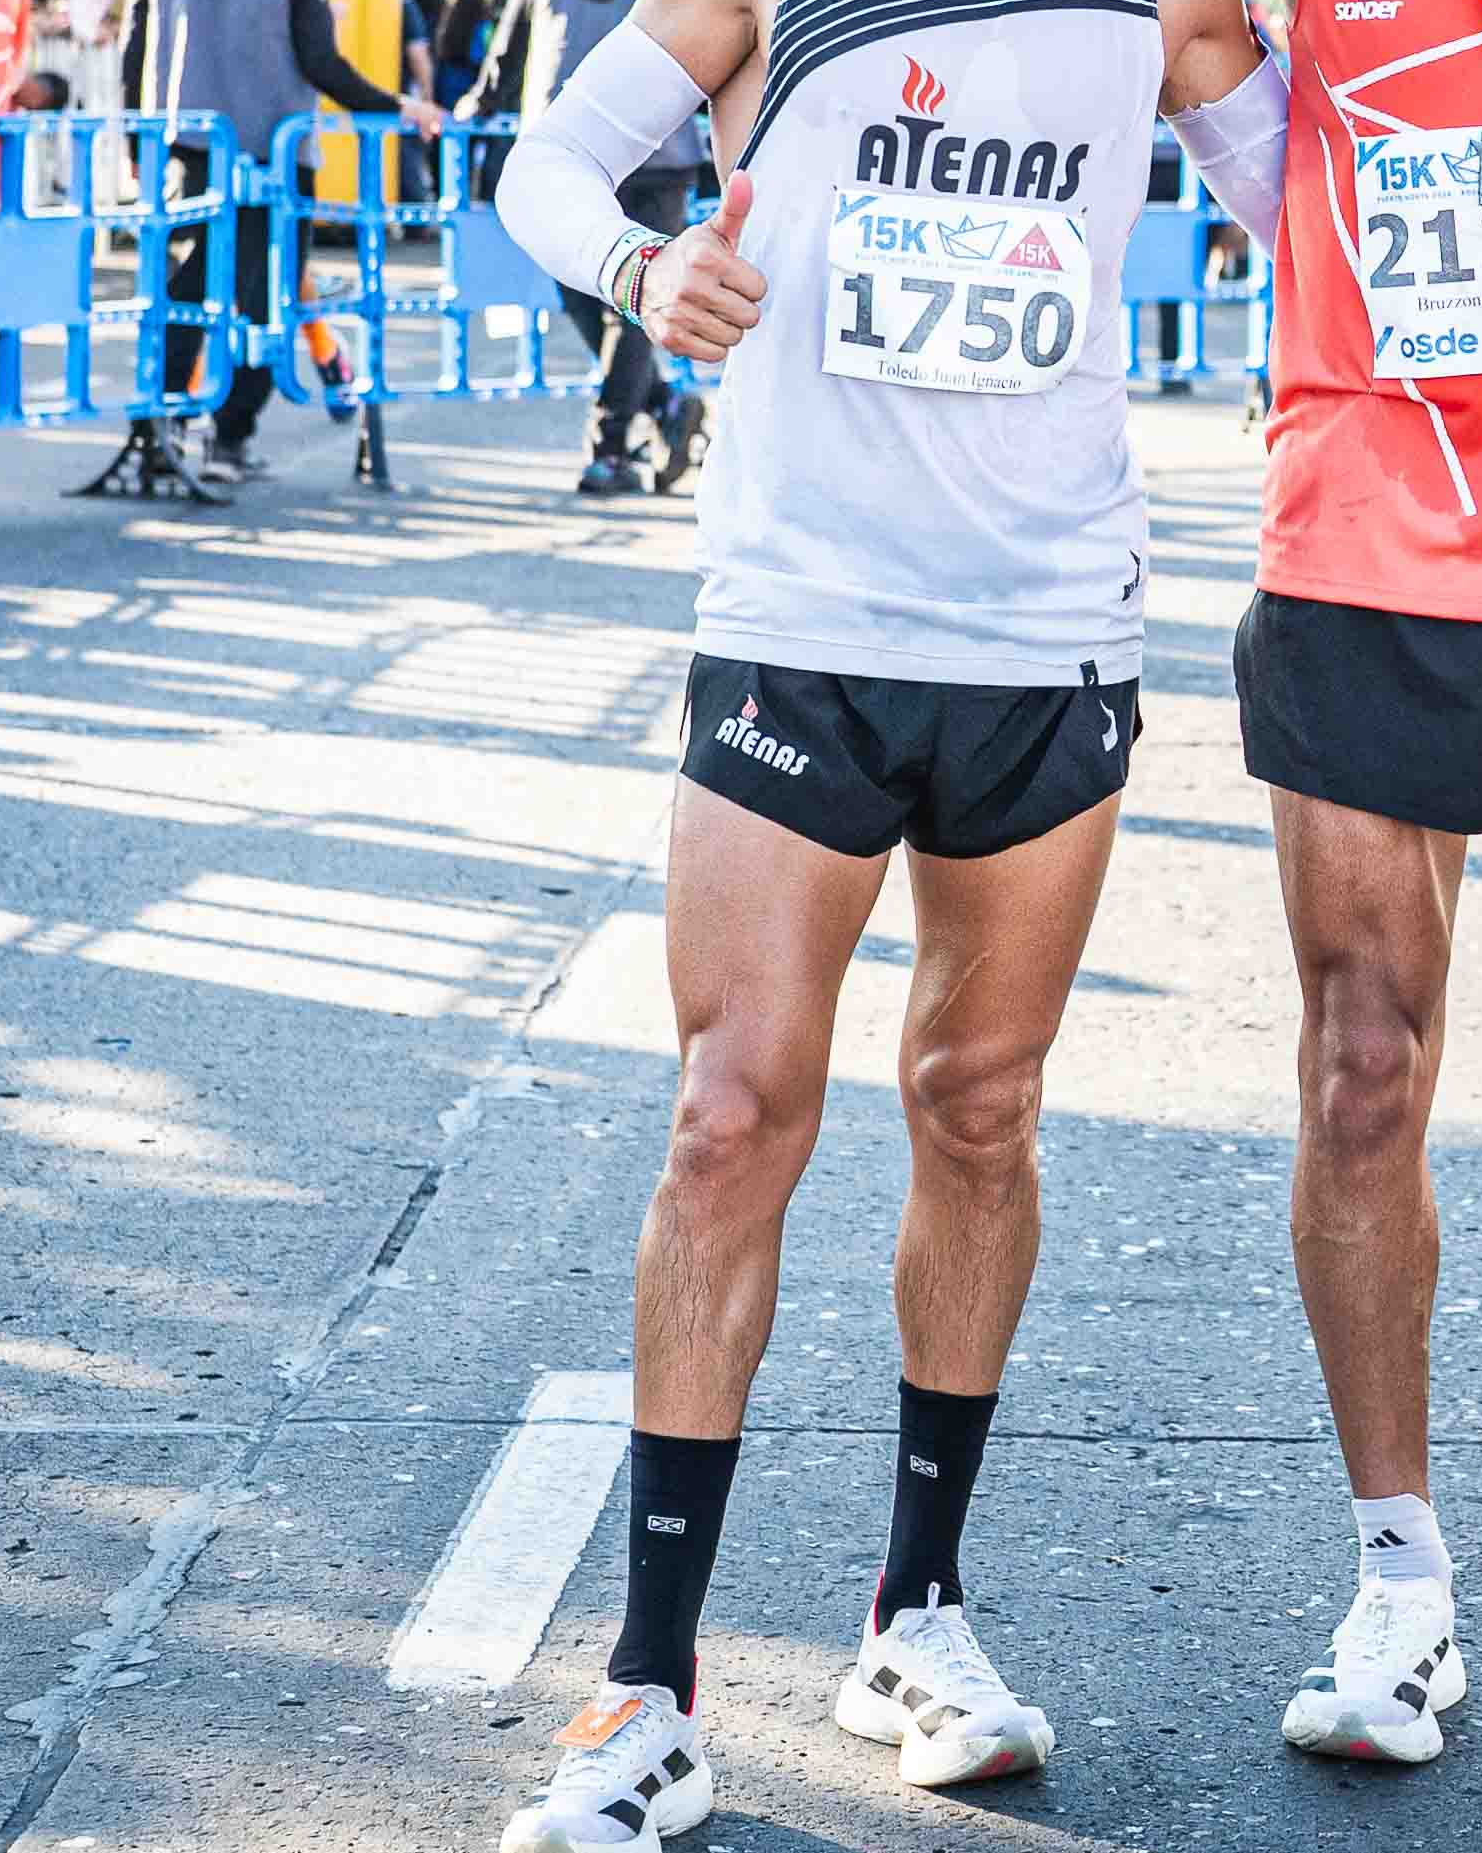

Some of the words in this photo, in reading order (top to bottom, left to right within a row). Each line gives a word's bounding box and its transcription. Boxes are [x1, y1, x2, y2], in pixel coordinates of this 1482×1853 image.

[856, 115, 1090, 202] ATENAS
[1375, 153, 1437, 191] 15K
[858, 214, 929, 254] 15K
[1016, 243, 1052, 267] 15K
[840, 273, 1075, 367] 1750
[1401, 326, 1479, 359] osde
[971, 371, 1022, 389] Ignacio
[714, 716, 810, 776] ATENAS
